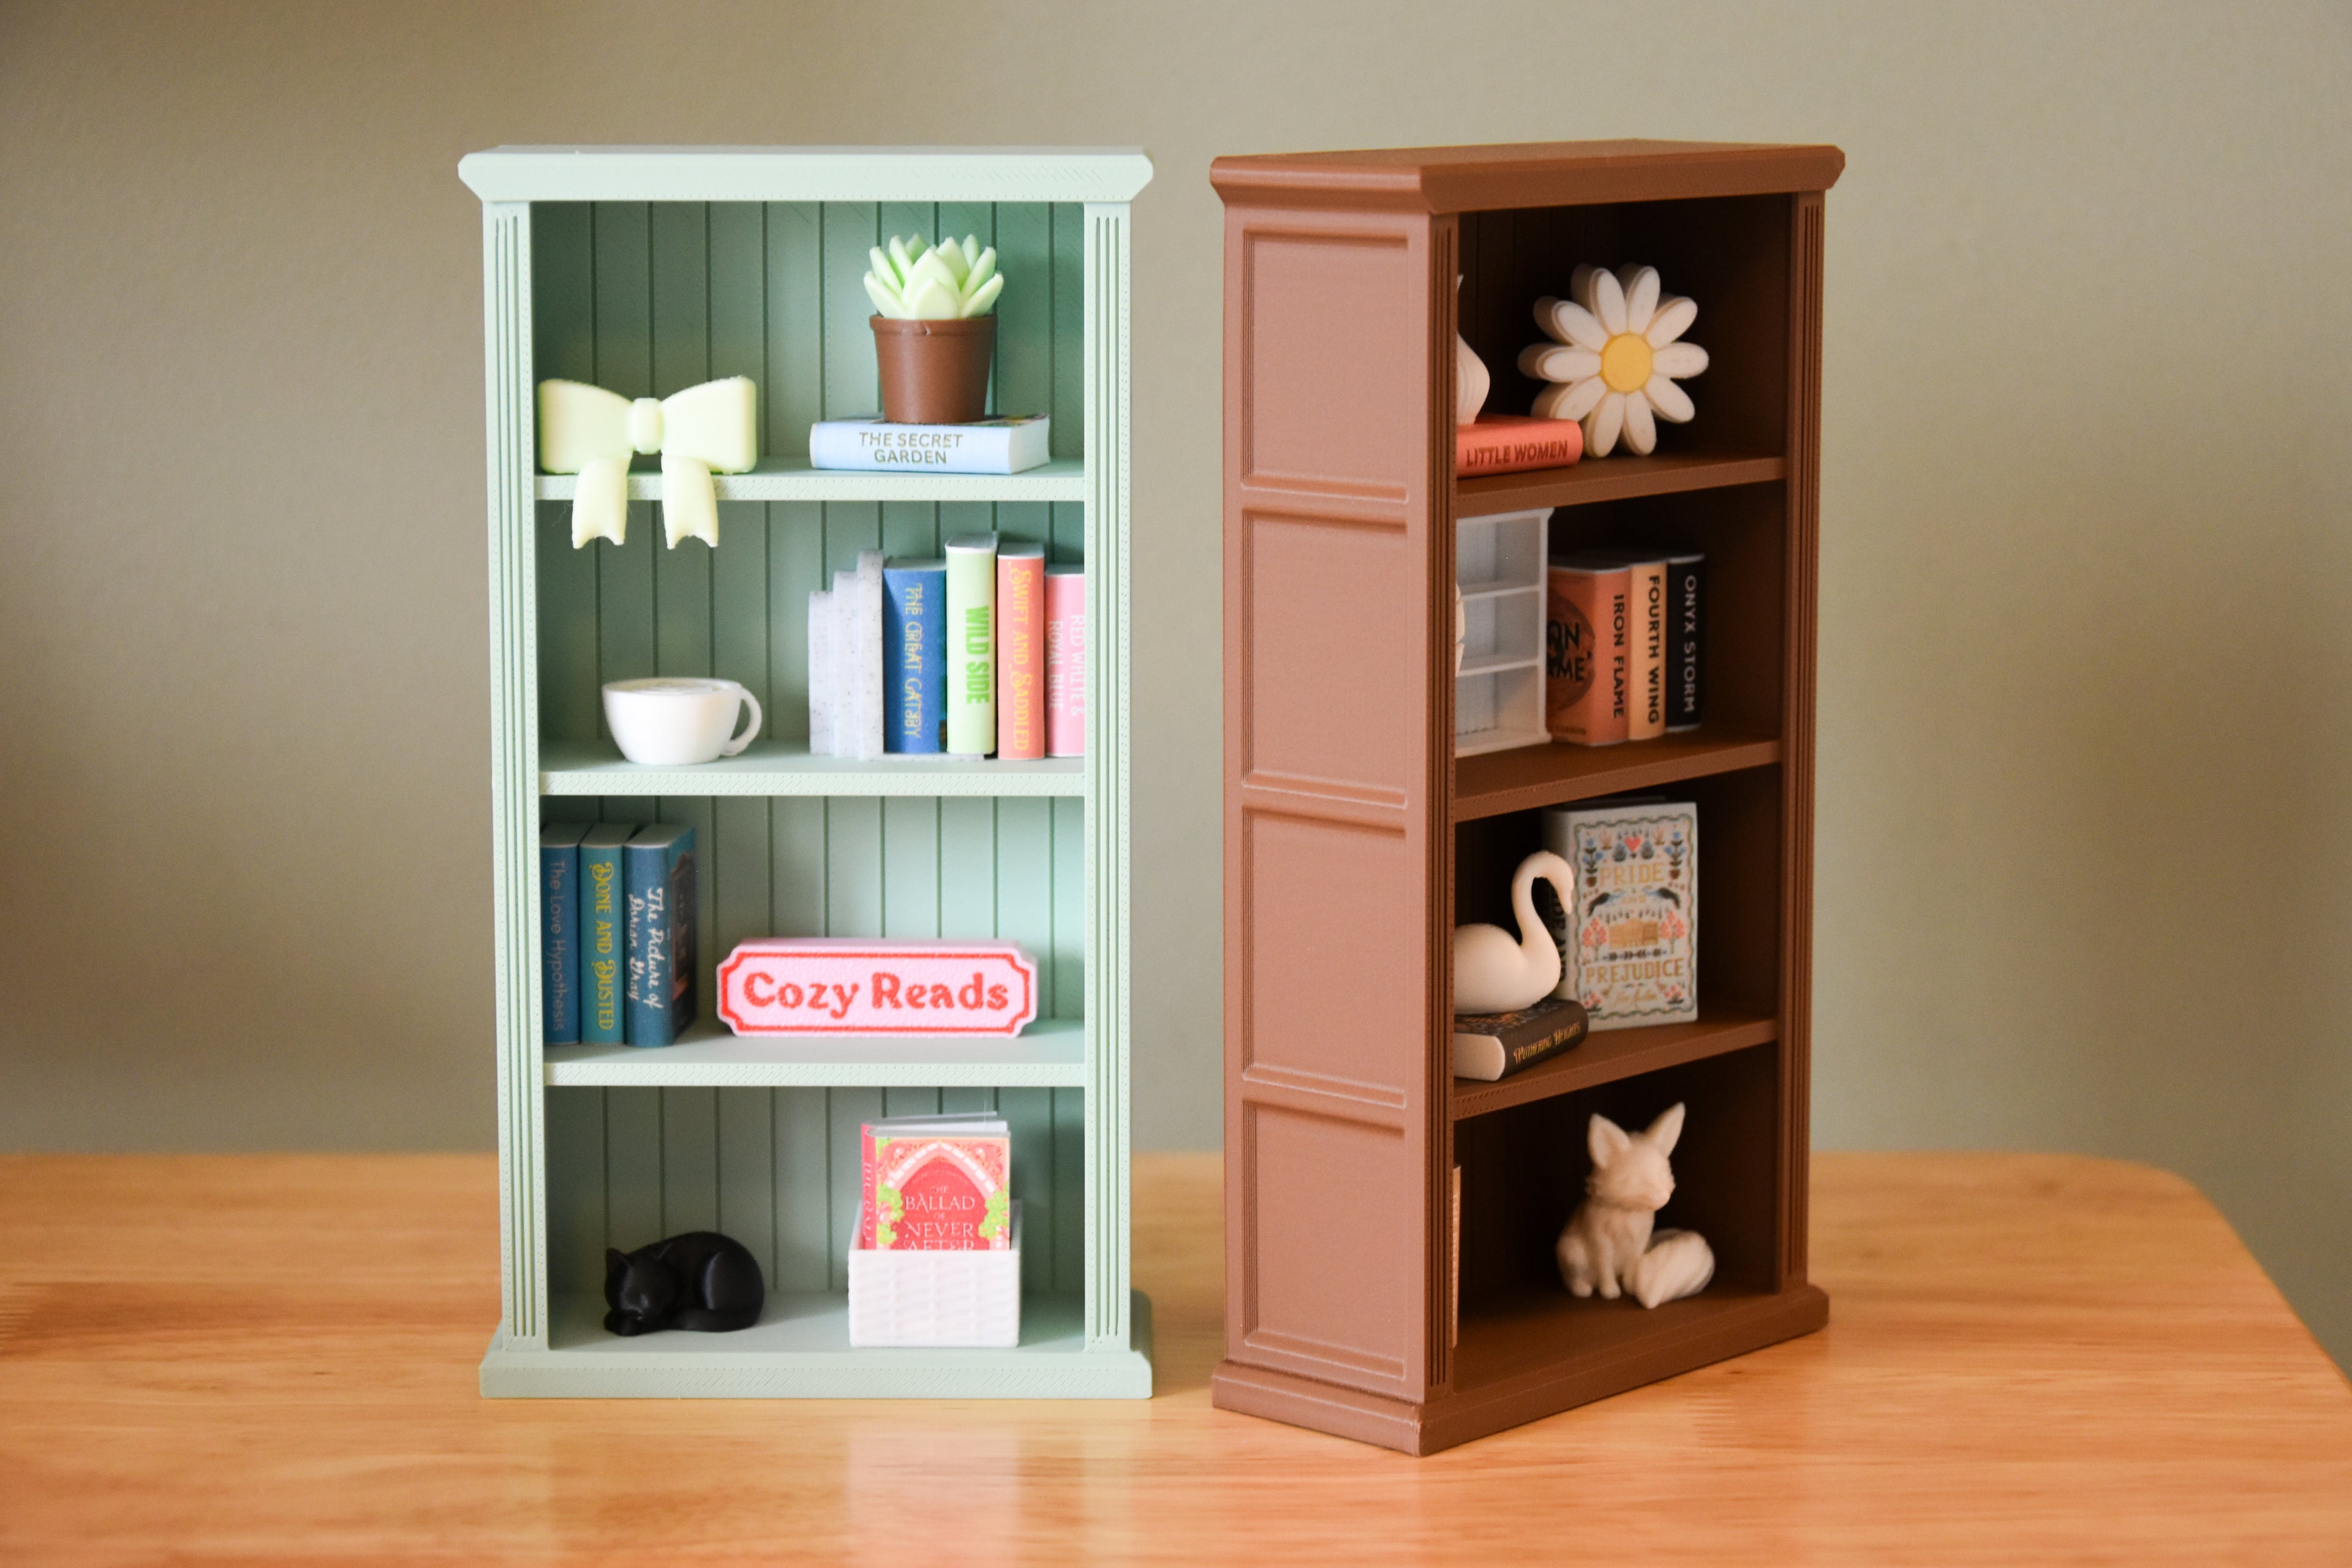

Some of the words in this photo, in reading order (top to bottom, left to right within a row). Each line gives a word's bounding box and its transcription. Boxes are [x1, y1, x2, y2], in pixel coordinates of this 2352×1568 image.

[859, 431, 892, 447] THE
[897, 432, 963, 449] SECRET
[874, 448, 947, 464] GARDEN
[1466, 445, 1511, 467] LITTLE
[1514, 440, 1568, 463] WOMEN
[1008, 561, 1032, 624] SWIFT
[1684, 575, 1697, 632] ONYX
[965, 606, 990, 655] WILD
[1613, 594, 1625, 647] IRON
[1648, 575, 1660, 658] FOURTH
[1014, 631, 1030, 666] AND
[965, 661, 990, 704] SIDE
[1613, 656, 1625, 719] FLAME
[1648, 666, 1659, 724] WING
[1684, 641, 1696, 712] STORM
[1008, 663, 1032, 751] SADDLED
[550, 861, 565, 890] The
[1599, 862, 1666, 888] PRIDE
[550, 895, 564, 934] Love
[647, 887, 665, 923] The
[595, 920, 612, 954] AND
[647, 927, 666, 989] Picture
[1585, 957, 1684, 984] PREJUDICE
[548, 938, 568, 1031] Hypothesis
[643, 992, 664, 1009] of
[743, 971, 859, 1019] Cozy
[871, 971, 1009, 1011] Reads
[905, 1193, 976, 1214] BALLAD
[903, 1220, 974, 1238] NEVER
